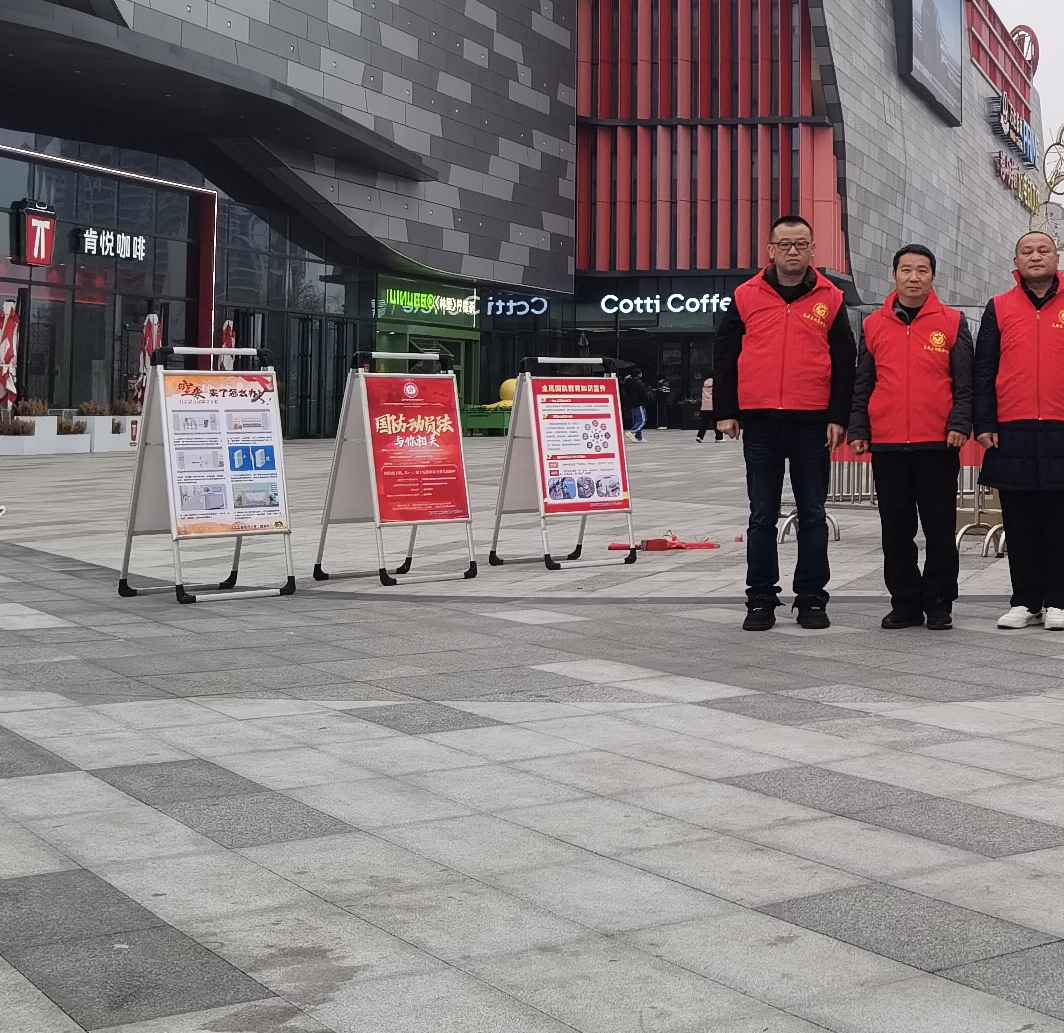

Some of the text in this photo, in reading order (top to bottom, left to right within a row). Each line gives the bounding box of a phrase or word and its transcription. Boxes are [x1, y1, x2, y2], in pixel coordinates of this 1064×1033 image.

[84, 228, 145, 261] 肯悦咖啡
[601, 294, 661, 314] Cotti
[375, 413, 455, 436] 国防动员法
